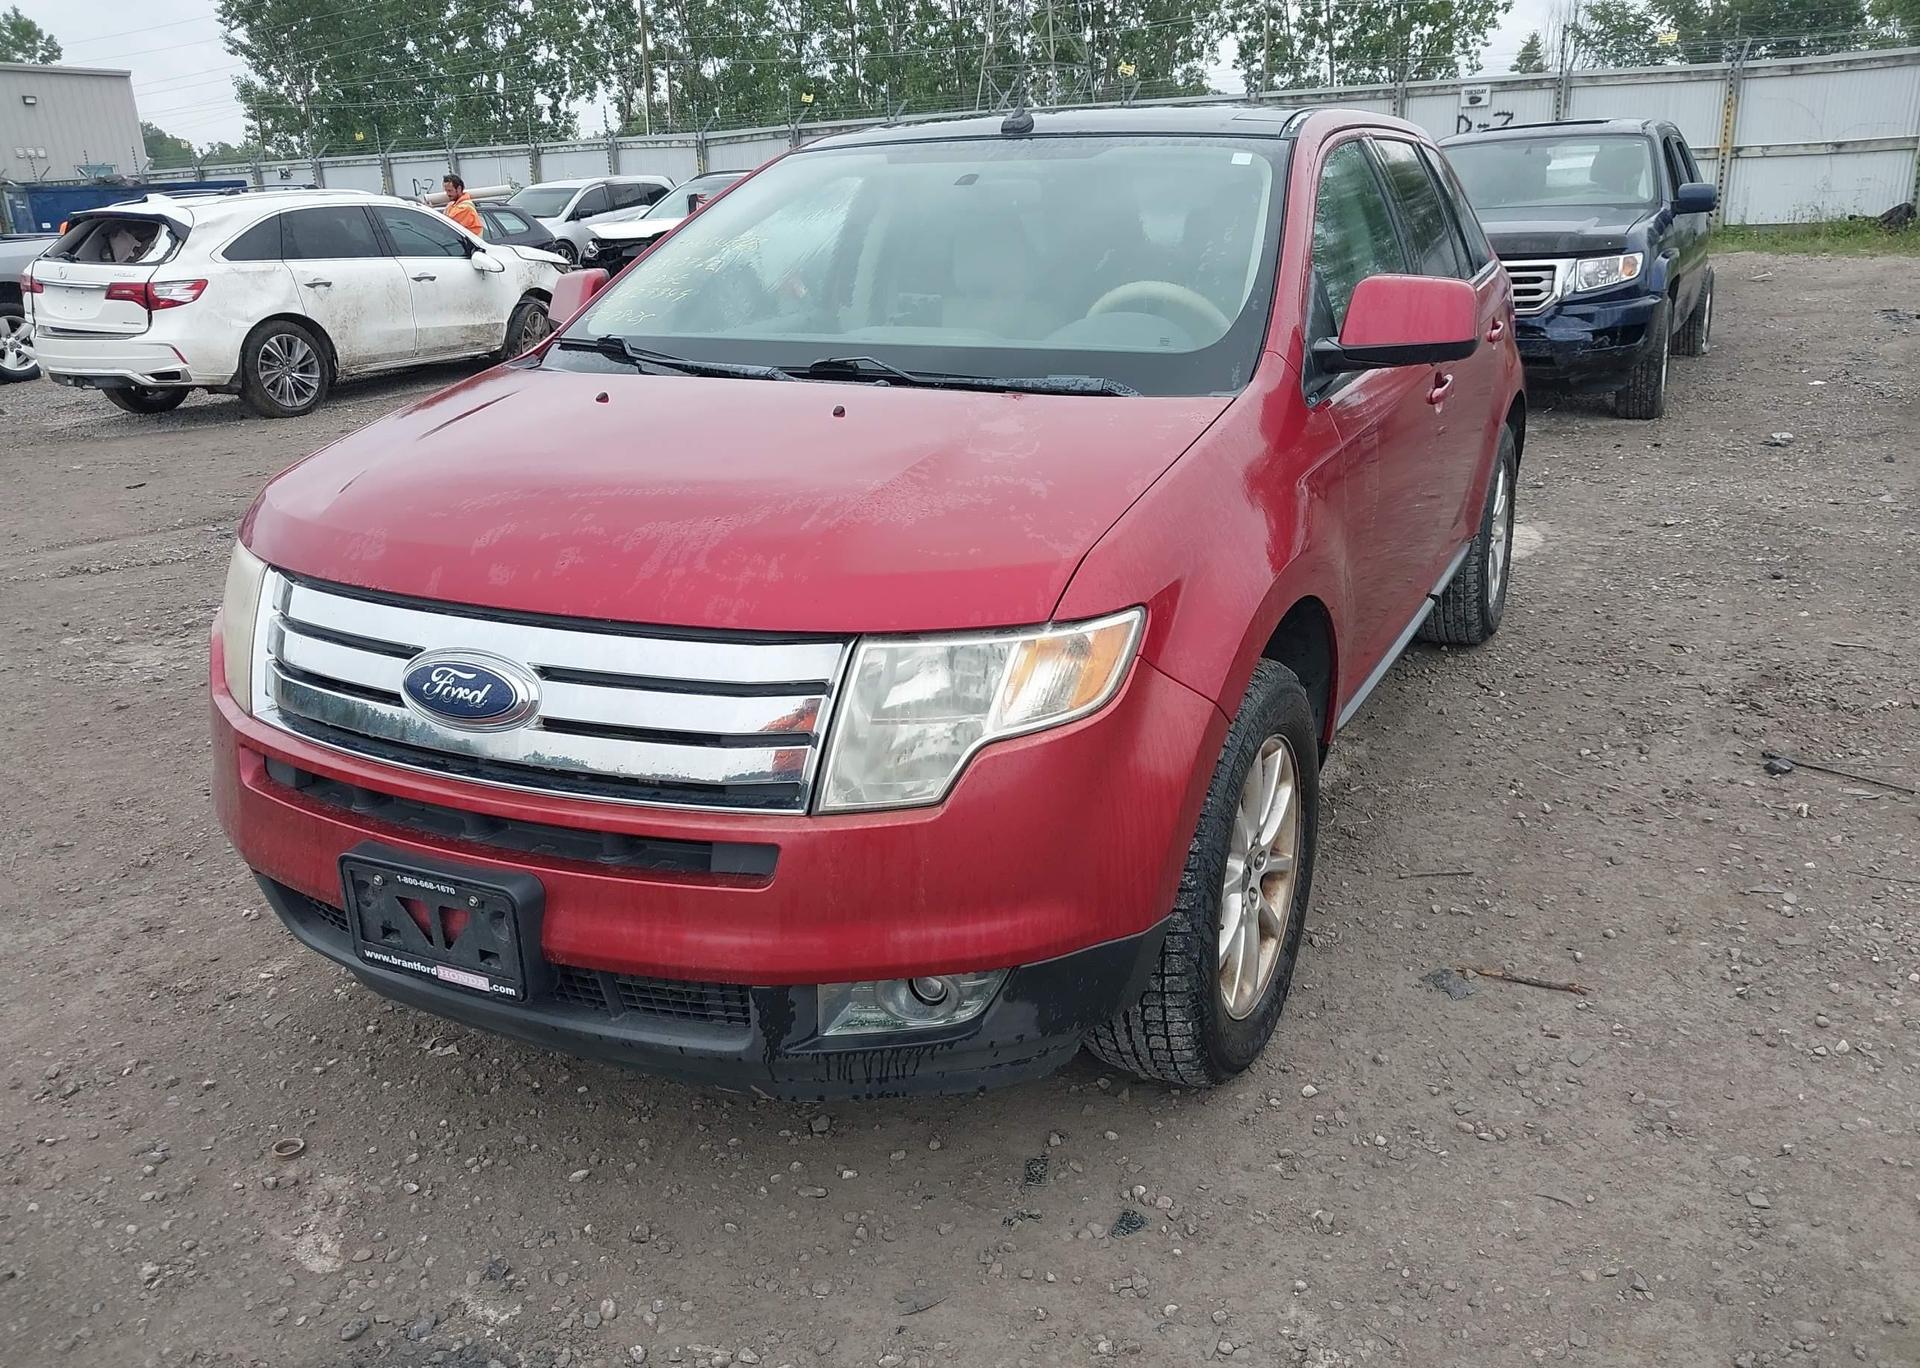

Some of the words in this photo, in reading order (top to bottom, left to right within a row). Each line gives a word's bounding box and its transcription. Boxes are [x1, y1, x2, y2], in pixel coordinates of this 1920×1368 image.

[1464, 88, 1487, 96] TUESDAY
[422, 666, 493, 706] Ford
[396, 875, 456, 895] 1-800-668-1670
